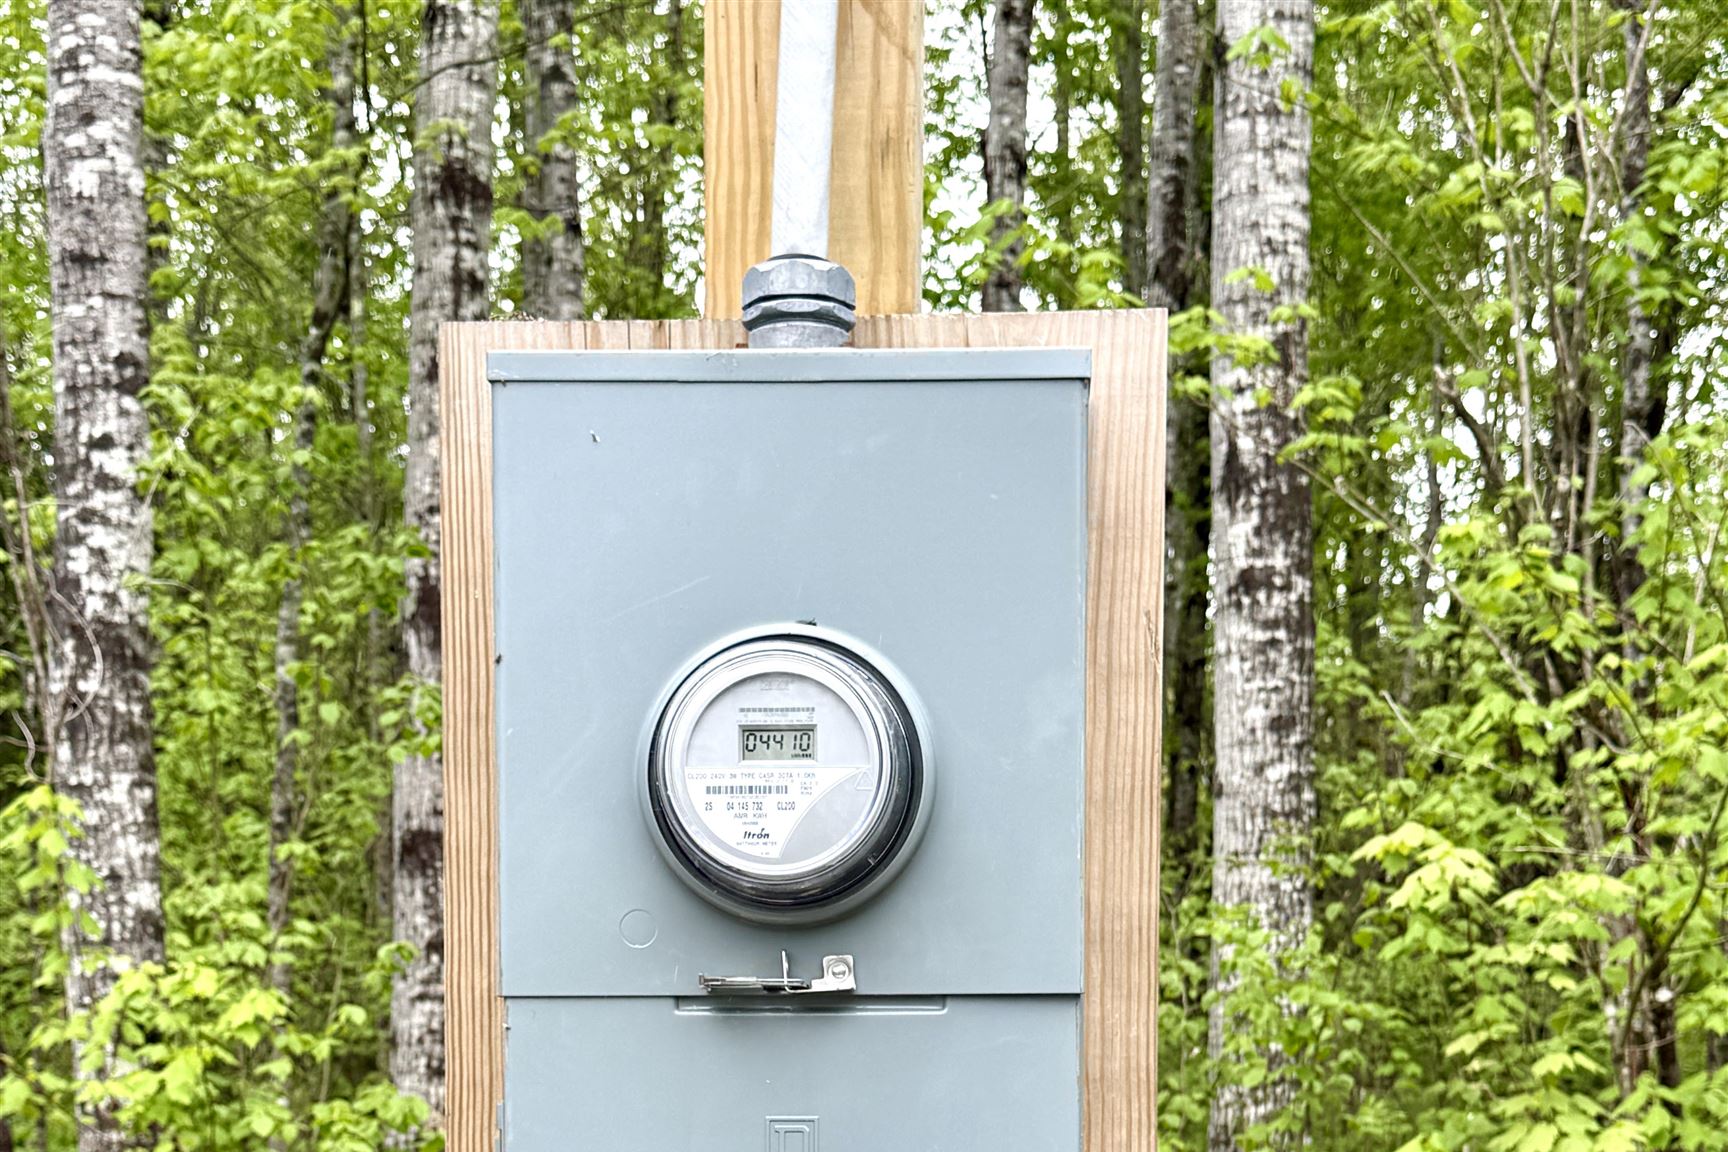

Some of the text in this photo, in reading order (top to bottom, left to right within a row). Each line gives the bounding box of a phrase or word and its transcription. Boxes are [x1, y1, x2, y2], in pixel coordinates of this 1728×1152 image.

[745, 732, 811, 752] 04410
[704, 801, 713, 811] 2S
[726, 801, 735, 811] 04
[738, 801, 749, 811] 145
[752, 801, 763, 811] 732
